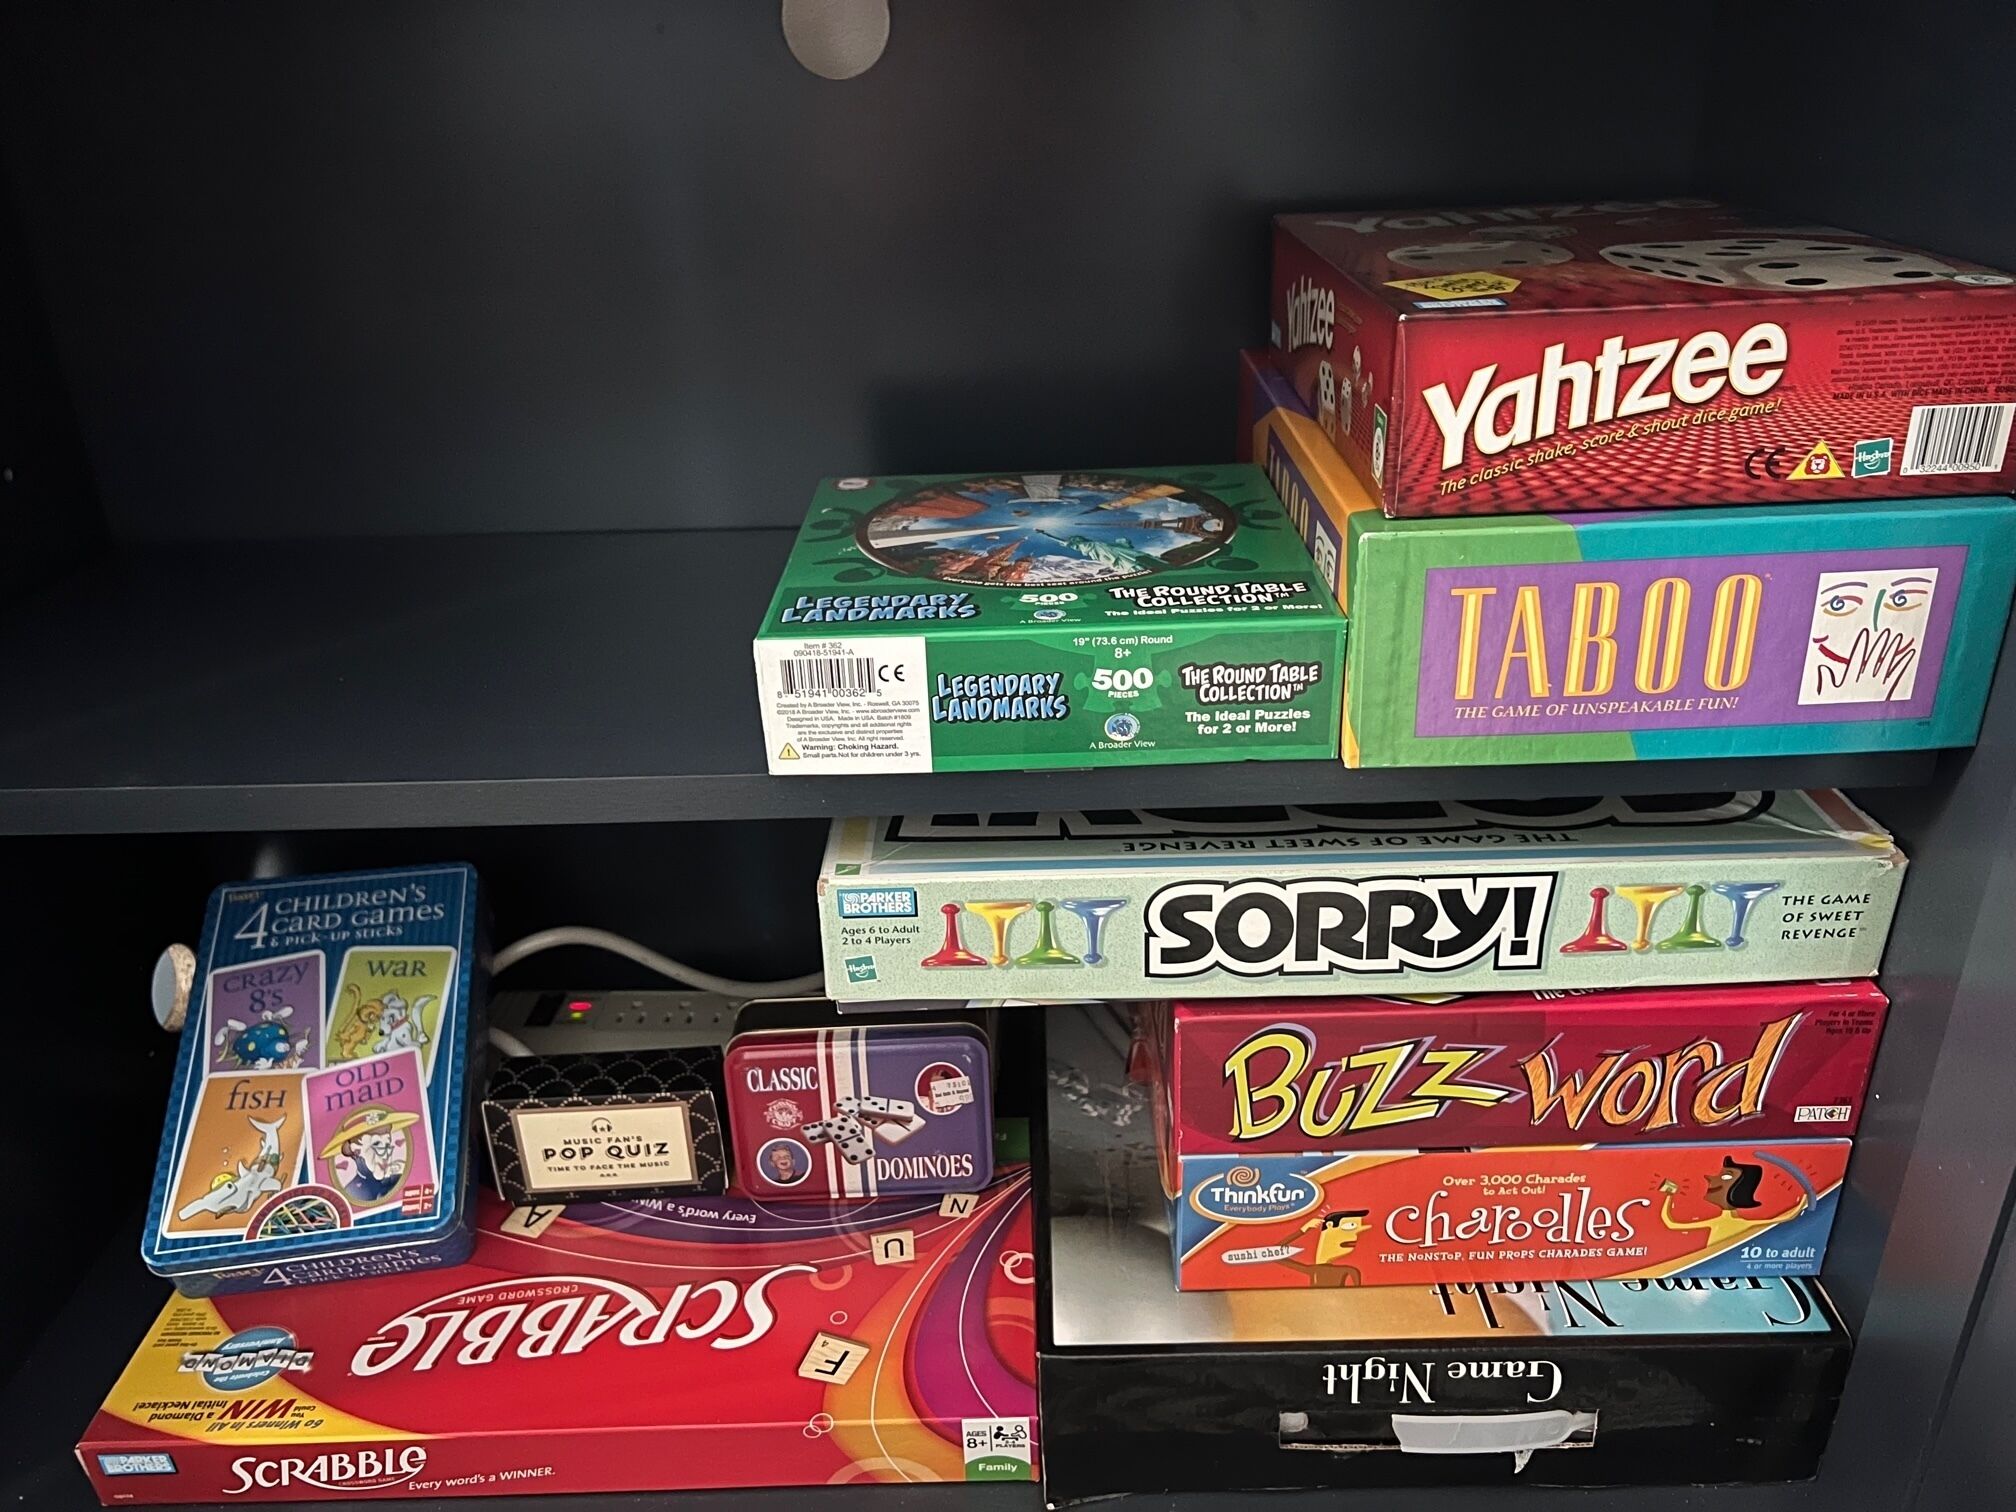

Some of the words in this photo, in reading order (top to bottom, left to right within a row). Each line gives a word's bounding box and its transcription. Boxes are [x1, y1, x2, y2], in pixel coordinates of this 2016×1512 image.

[1287, 275, 1335, 352] Yahtzee
[1423, 322, 1788, 471] Yahtzee
[1440, 477, 1466, 496] The
[1469, 456, 1524, 484] classic
[1527, 441, 1577, 465] shake,
[1581, 430, 1625, 452] score
[1627, 423, 1640, 439] &
[1643, 414, 1689, 436] shout
[1692, 408, 1726, 426] dice
[1727, 398, 1782, 424] game!
[1019, 592, 1079, 603] 500
[1109, 587, 1148, 599] THE
[1154, 585, 1232, 598] ROUND
[1235, 582, 1307, 595] TABLE
[796, 593, 968, 610] LEGENDARY
[781, 604, 976, 624] LANDMARKS
[1092, 636, 1118, 648] (73.6
[1119, 636, 1139, 647] cm)
[1140, 634, 1174, 645] Round
[1450, 573, 1762, 700] TABOO
[1114, 647, 1131, 659] 8+
[1092, 667, 1154, 690] 500
[1182, 666, 1210, 685] THE
[1212, 665, 1267, 685] ROUND
[1269, 662, 1319, 683] TABLE
[937, 672, 1060, 699] LEGENDARY
[794, 690, 828, 699] 51941
[832, 689, 866, 698] 00362
[1107, 689, 1139, 699] PIECES
[932, 695, 1067, 722] LANDMARKS
[1185, 711, 1211, 722] The
[1215, 710, 1250, 721] Ideal
[1255, 708, 1311, 720] Puzzles
[1455, 706, 1487, 720] THE
[1492, 705, 1542, 719] GAME
[1546, 703, 1570, 717] OF
[1572, 699, 1694, 716] UNSPEAKABLE
[1697, 697, 1739, 710] FUN!
[1197, 724, 1219, 734] for
[1222, 723, 1231, 734] 2
[1235, 724, 1251, 733] or
[1255, 721, 1297, 732] More!
[801, 743, 836, 751] Warning:
[838, 743, 869, 751] Choking
[1089, 742, 1097, 750] A
[1098, 739, 1132, 750] Broader
[1134, 739, 1156, 749] View
[1266, 838, 1360, 849] SWEET
[1416, 834, 1506, 845] GAME
[1513, 833, 1578, 843] THE
[1122, 840, 1256, 851] REVENGE
[859, 891, 911, 903] PARKER
[1782, 895, 1815, 906] THE
[1820, 893, 1871, 905] GAME
[842, 901, 912, 914] BROTHERS
[1782, 912, 1805, 923] OF
[1809, 910, 1864, 922] SWEET
[234, 902, 269, 949] 4
[841, 926, 867, 936] Ages
[869, 926, 876, 935] 6
[878, 926, 890, 935] to
[892, 924, 921, 935] Adult
[1150, 876, 1552, 973] SORRY!
[842, 937, 849, 945] 2
[851, 937, 862, 945] to
[865, 936, 872, 945] 4
[875, 936, 911, 946] Players
[1781, 928, 1857, 940] REVENGE
[335, 1061, 390, 1088] OLD
[747, 1066, 818, 1092] CLASSIC
[1797, 1108, 1849, 1121] PATCH
[563, 1137, 603, 1146] MUSIC
[607, 1135, 643, 1144] FAN'S
[543, 1146, 594, 1162] POP
[607, 1142, 669, 1160] QUIZ
[640, 1160, 670, 1168] MUSIC
[877, 1153, 973, 1181] DOMINOES
[1443, 1176, 1476, 1187] Over
[1525, 1173, 1587, 1185] Charades
[1482, 1187, 1496, 1196] to
[1498, 1186, 1518, 1196] Act
[1521, 1185, 1546, 1196] Out!
[666, 1203, 676, 1211] a
[678, 1204, 720, 1219] word's
[1224, 1204, 1267, 1213] Everybody
[722, 1210, 757, 1224] Every
[1228, 1251, 1258, 1261] sushi
[1261, 1245, 1291, 1258] chef?
[1379, 1253, 1404, 1263] THE
[1468, 1251, 1495, 1261] FUN
[1539, 1248, 1602, 1258] CHARADES
[1607, 1246, 1648, 1257] GAME!
[1741, 1246, 1762, 1259] 10
[1766, 1248, 1778, 1258] to
[1782, 1246, 1816, 1258] adult
[457, 1293, 494, 1305] GAME
[498, 1284, 579, 1301] CROSSWORD
[180, 1350, 311, 1373] DIAMOND
[1322, 1356, 1436, 1404] Night
[1447, 1360, 1563, 1403] Game
[148, 1410, 202, 1423] Diamond
[217, 1399, 298, 1420] WIN
[966, 1438, 988, 1449] 8+
[978, 1463, 1018, 1473] Family
[408, 1480, 442, 1491] Every
[445, 1474, 486, 1487] word's
[499, 1467, 556, 1481] WINNER.
